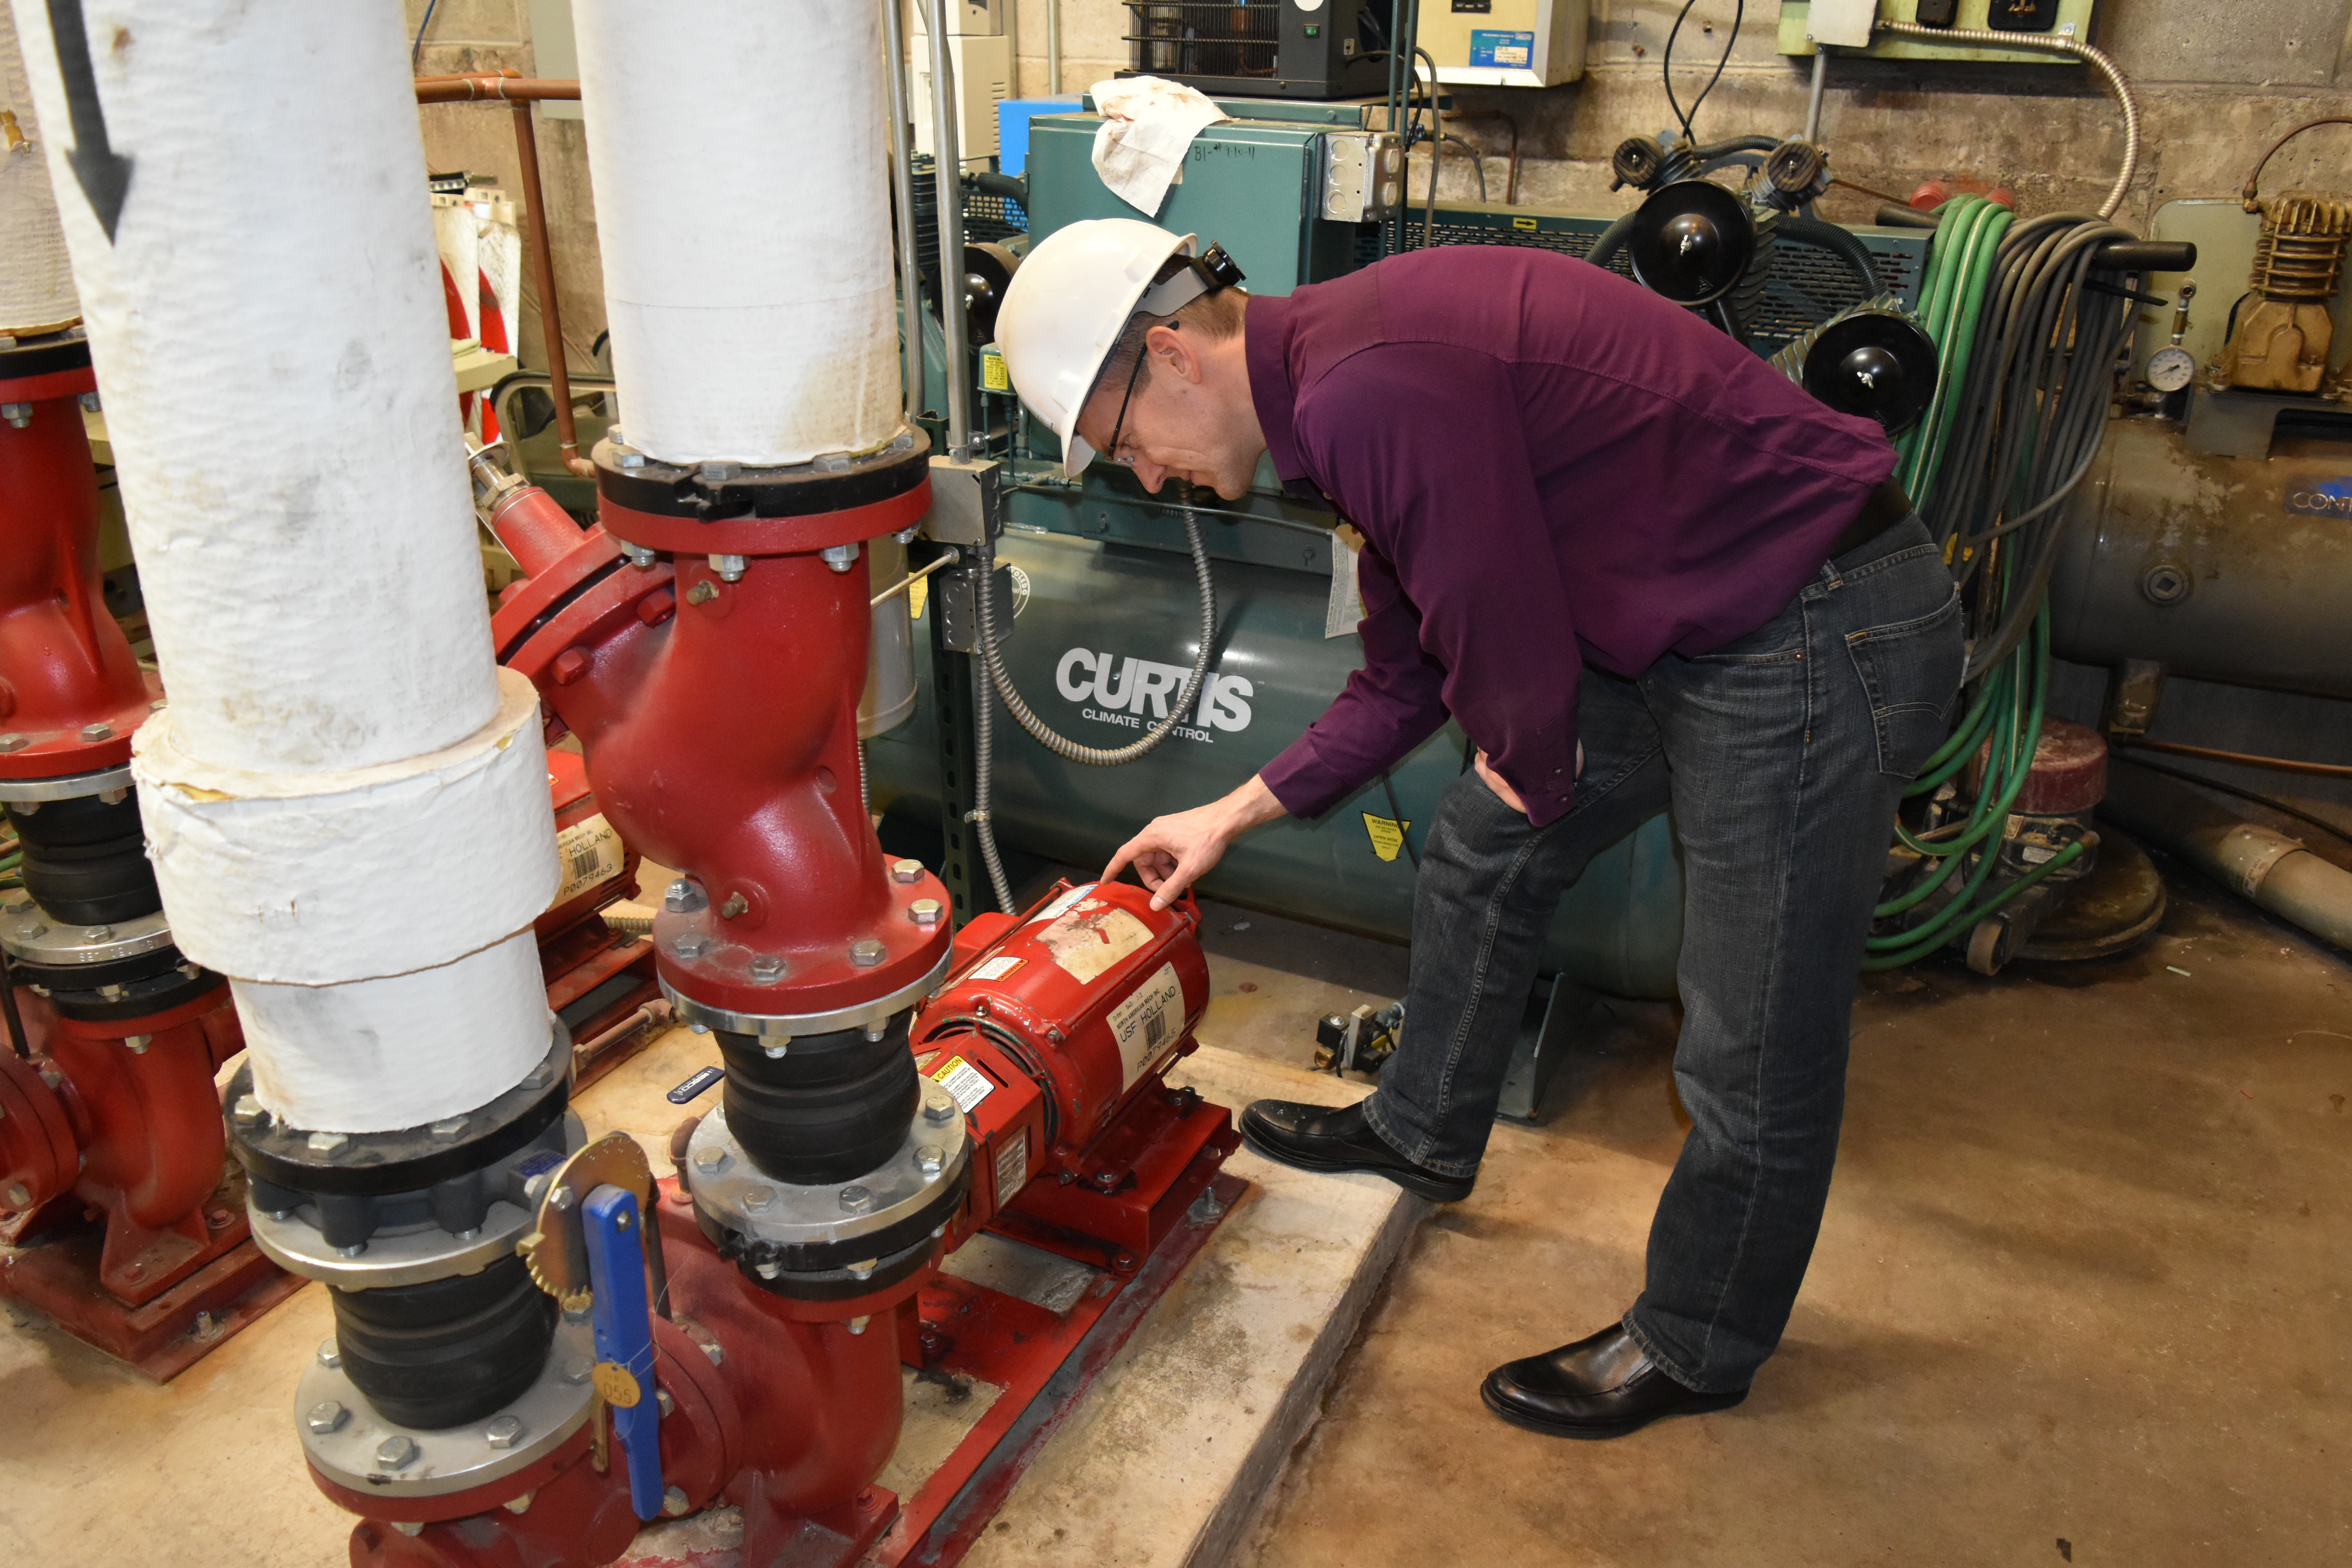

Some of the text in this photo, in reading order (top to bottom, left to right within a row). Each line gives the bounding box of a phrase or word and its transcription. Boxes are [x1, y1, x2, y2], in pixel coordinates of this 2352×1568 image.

[1056, 647, 1254, 732] CURTIS
[1082, 708, 1140, 728] CLIMATE
[568, 828, 612, 857] HOLLAND
[563, 863, 613, 897] P0079463
[998, 964, 1020, 980] WARNING
[1117, 1016, 1128, 1030] NORTH
[1128, 1002, 1145, 1020] AMERICAN
[1144, 994, 1154, 1005] MECH
[1120, 1021, 1136, 1042] USF
[1140, 985, 1176, 1024] HOLLAND
[1137, 1027, 1176, 1072] P0079465
[682, 1073, 710, 1092] NIBCO
[937, 1058, 962, 1079] CAUTION
[604, 1381, 632, 1405] 055
